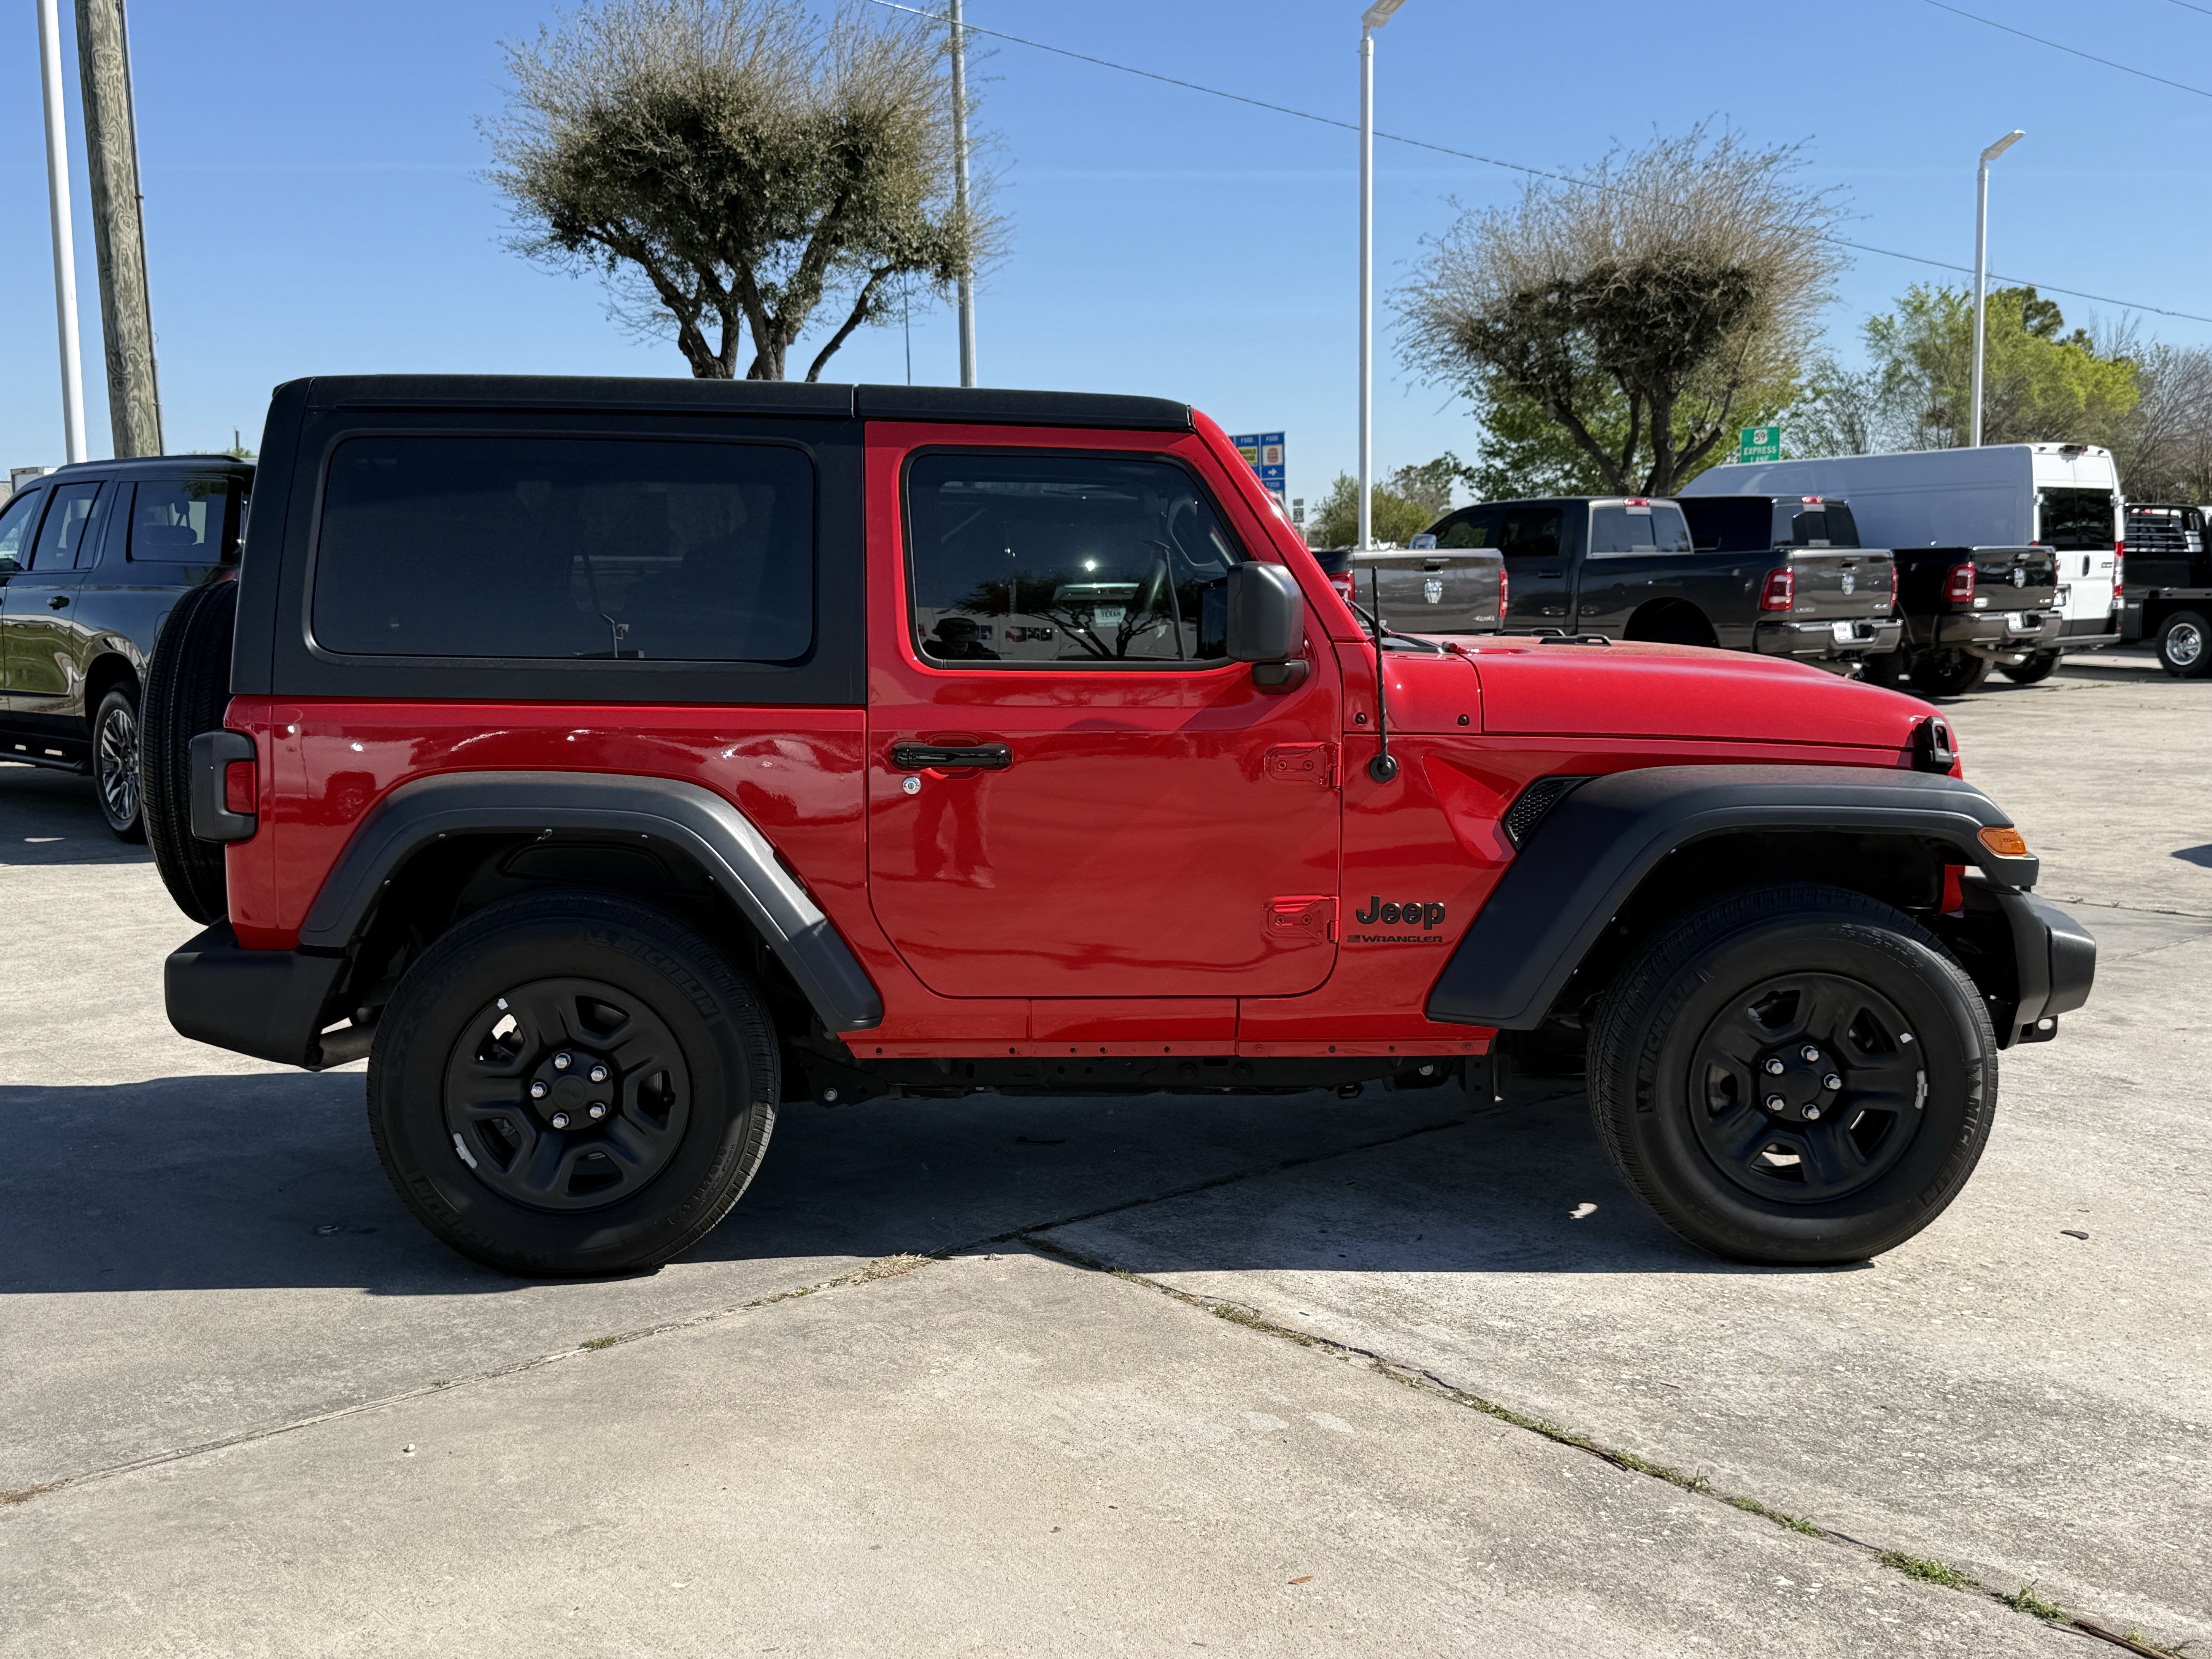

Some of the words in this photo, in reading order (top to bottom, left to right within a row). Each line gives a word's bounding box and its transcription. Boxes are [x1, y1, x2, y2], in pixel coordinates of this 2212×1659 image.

[1743, 445, 1777, 455] EXPRESS
[1356, 895, 1445, 930] Jeep
[613, 935, 720, 1015] MICHELIN
[1638, 970, 1699, 1084] MICHELIN
[1923, 1096, 1980, 1207] MICHELIN
